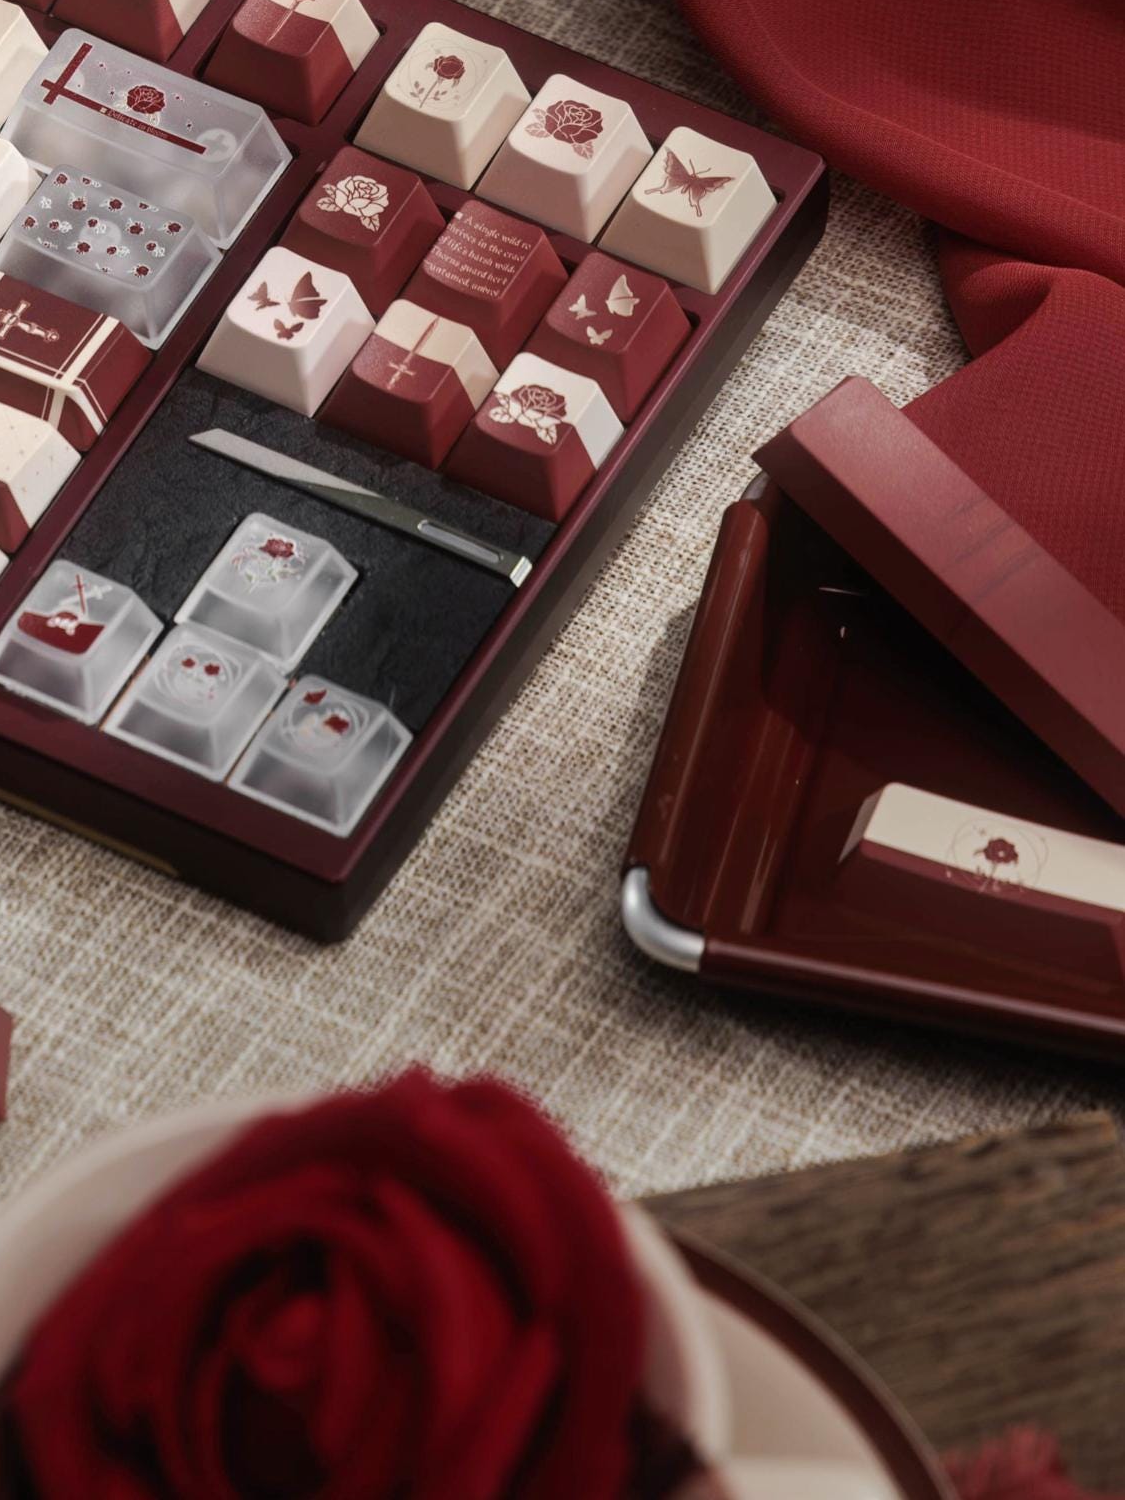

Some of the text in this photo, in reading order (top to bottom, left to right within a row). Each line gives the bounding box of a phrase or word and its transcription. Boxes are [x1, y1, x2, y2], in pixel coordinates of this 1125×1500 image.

[473, 222, 500, 240] single
[501, 234, 521, 247] wild
[459, 262, 488, 280] guard
